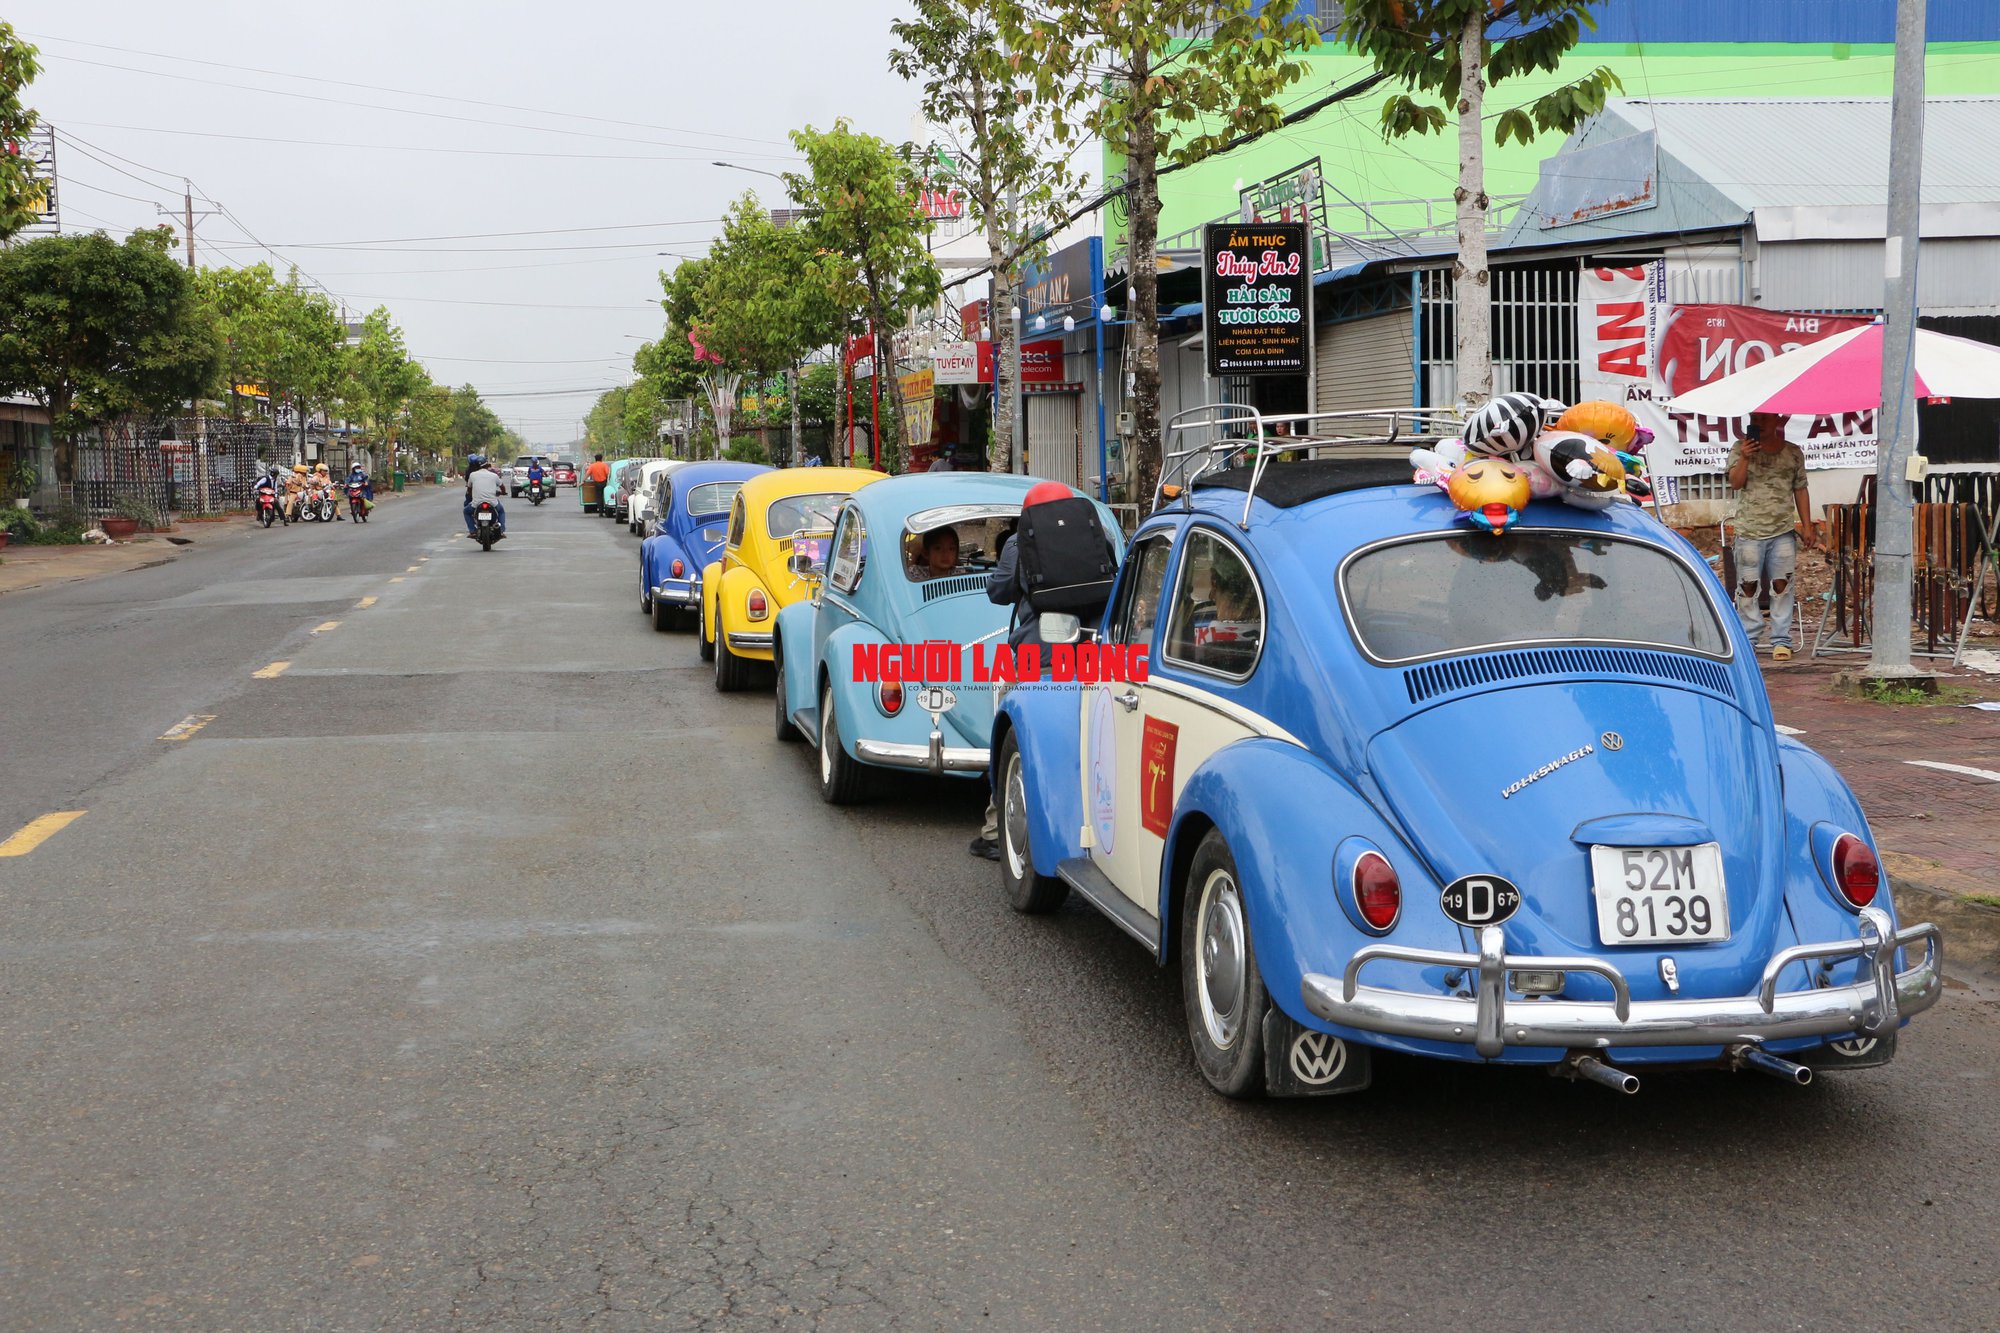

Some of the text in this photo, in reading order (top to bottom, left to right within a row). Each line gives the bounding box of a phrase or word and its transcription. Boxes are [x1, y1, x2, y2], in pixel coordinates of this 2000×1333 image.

[1228, 230, 1287, 250] ẨM THỰC
[1217, 251, 1258, 284] Thúy
[1288, 252, 1300, 276] 2
[1063, 273, 1070, 303] 2
[1227, 284, 1291, 303] HẢI SẢN
[1218, 304, 1301, 324] TƯƠI SỐNG
[1262, 337, 1279, 345] SINH
[1596, 301, 1647, 378] AN
[936, 352, 961, 369] TUYẾT
[1807, 409, 1874, 439] AN
[1674, 457, 1702, 467] NHẬN
[1854, 448, 1877, 458] CƠM
[1502, 744, 1594, 799] VOLKSWAGEN
[1622, 850, 1696, 891] 52M
[1449, 880, 1513, 921] 19 D 67
[1616, 895, 1712, 937] 8139
